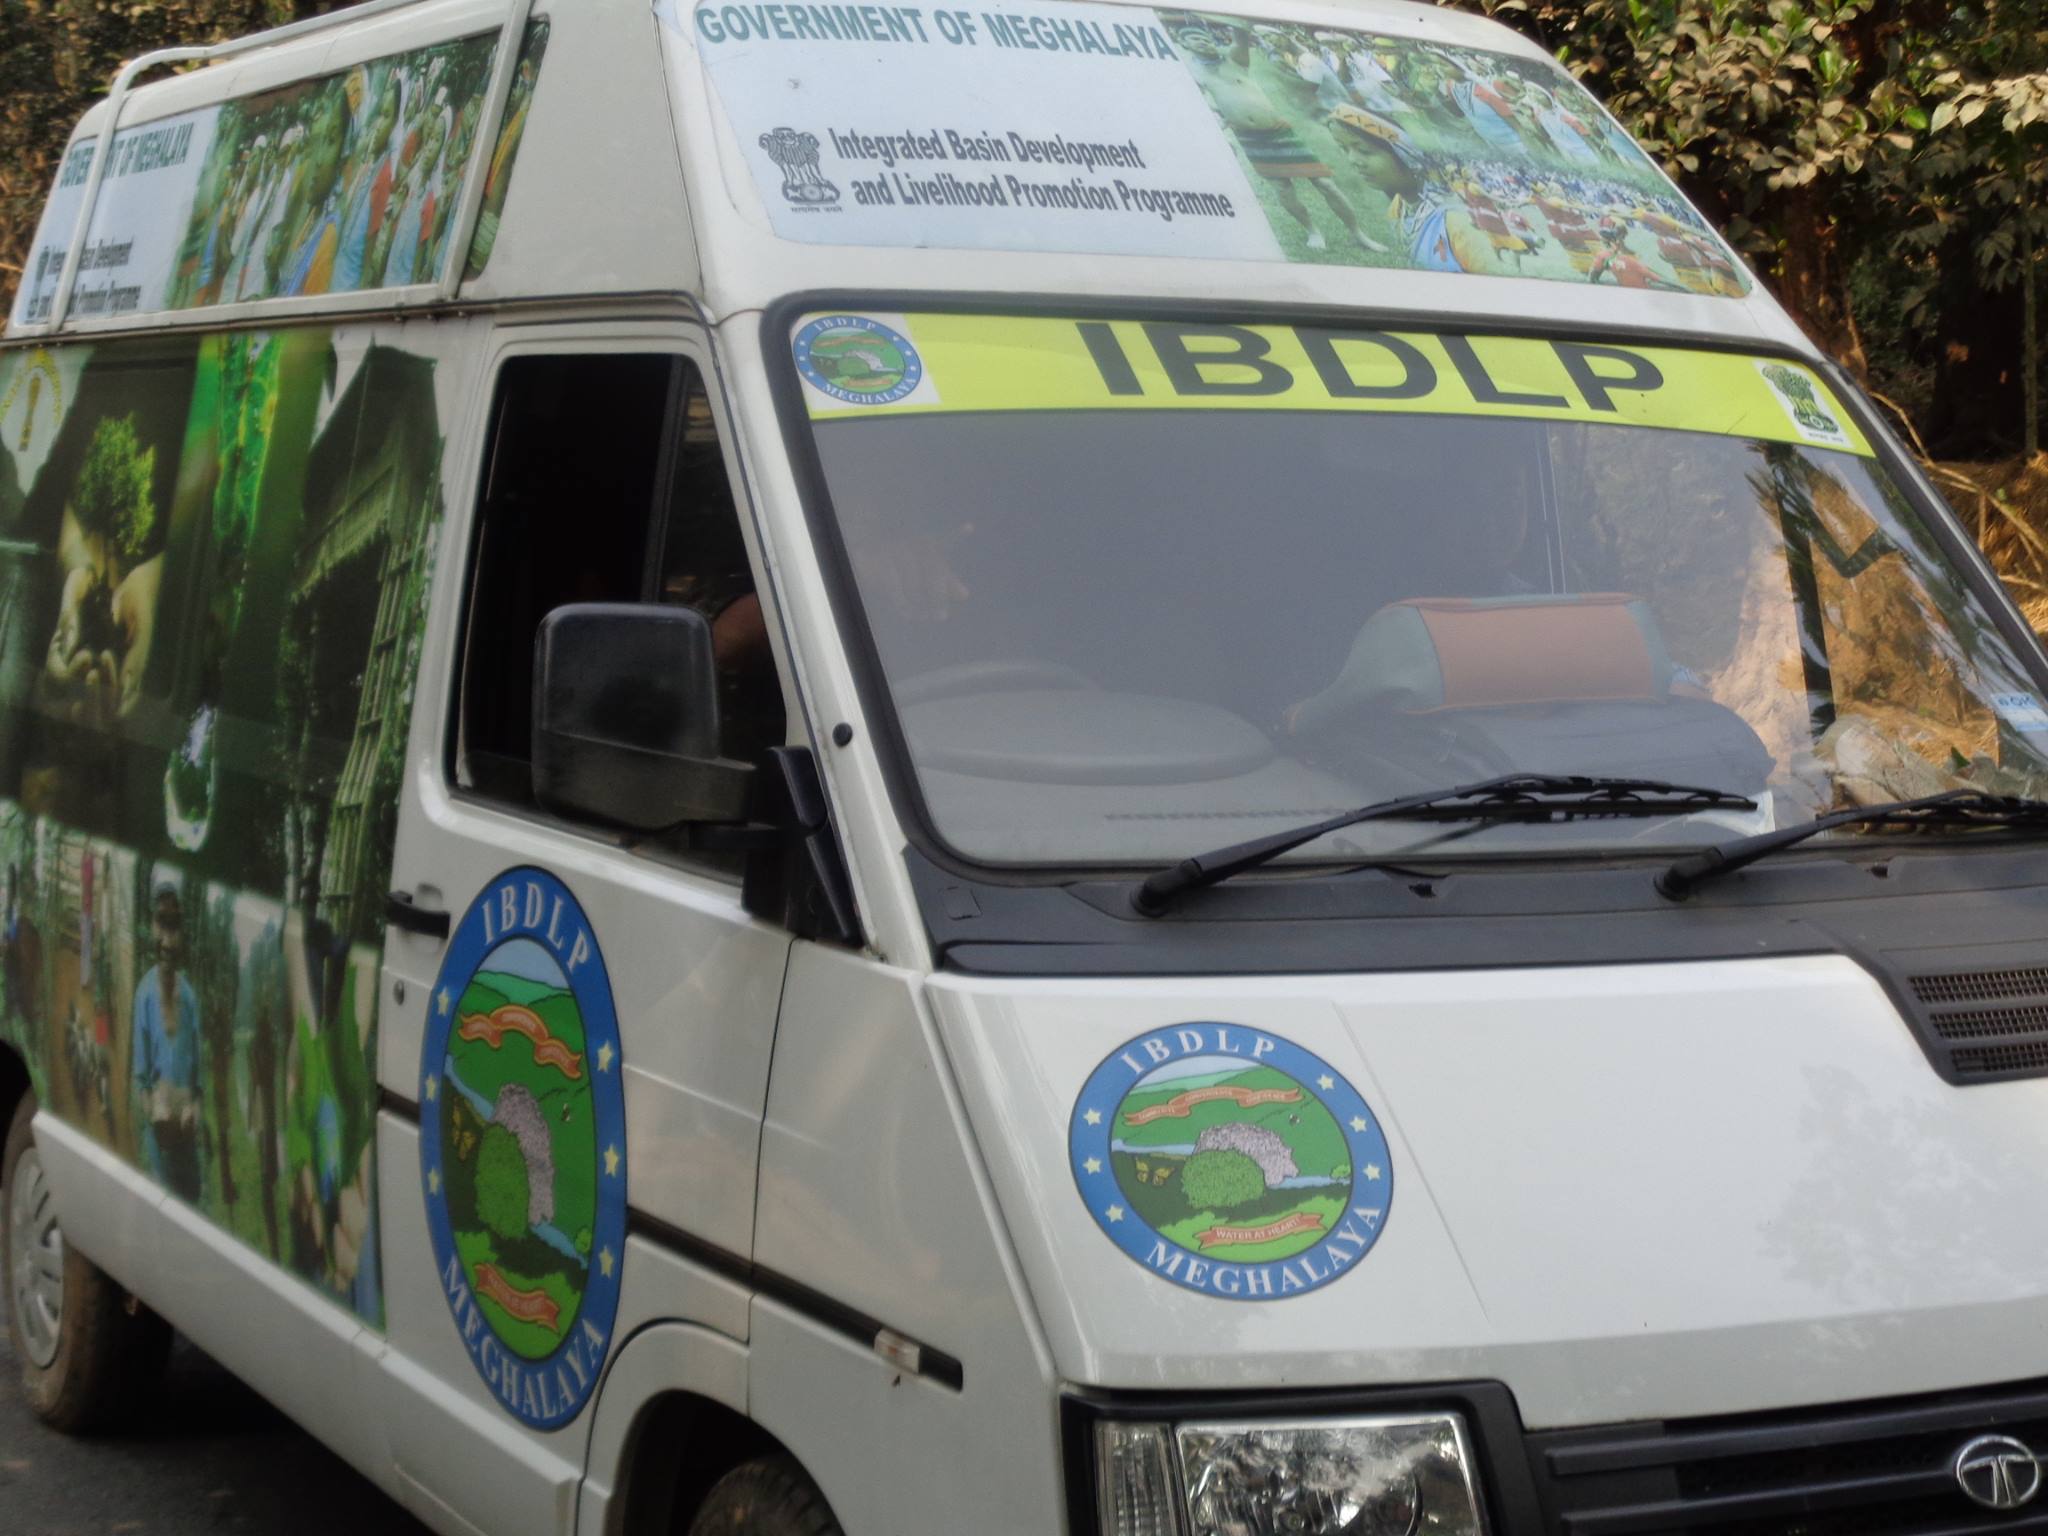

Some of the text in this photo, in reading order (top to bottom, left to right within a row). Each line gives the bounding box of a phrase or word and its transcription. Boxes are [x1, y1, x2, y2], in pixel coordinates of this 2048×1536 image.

[698, 5, 1179, 61] GOVERNMENT OF MEGHALAYA
[827, 127, 1146, 173] Integrated Basin Development
[850, 172, 1236, 222] and Livelihood Promotion Programme
[814, 316, 876, 331] IBDLP
[822, 378, 917, 404] MEGHALAYA
[1074, 320, 1665, 412] IBDLP
[482, 881, 590, 971] IBDLP
[1121, 1028, 1275, 1075] IBDLP
[1145, 1206, 1381, 1296] MEGHALAYA
[443, 1260, 602, 1420] MEGHALAYA
